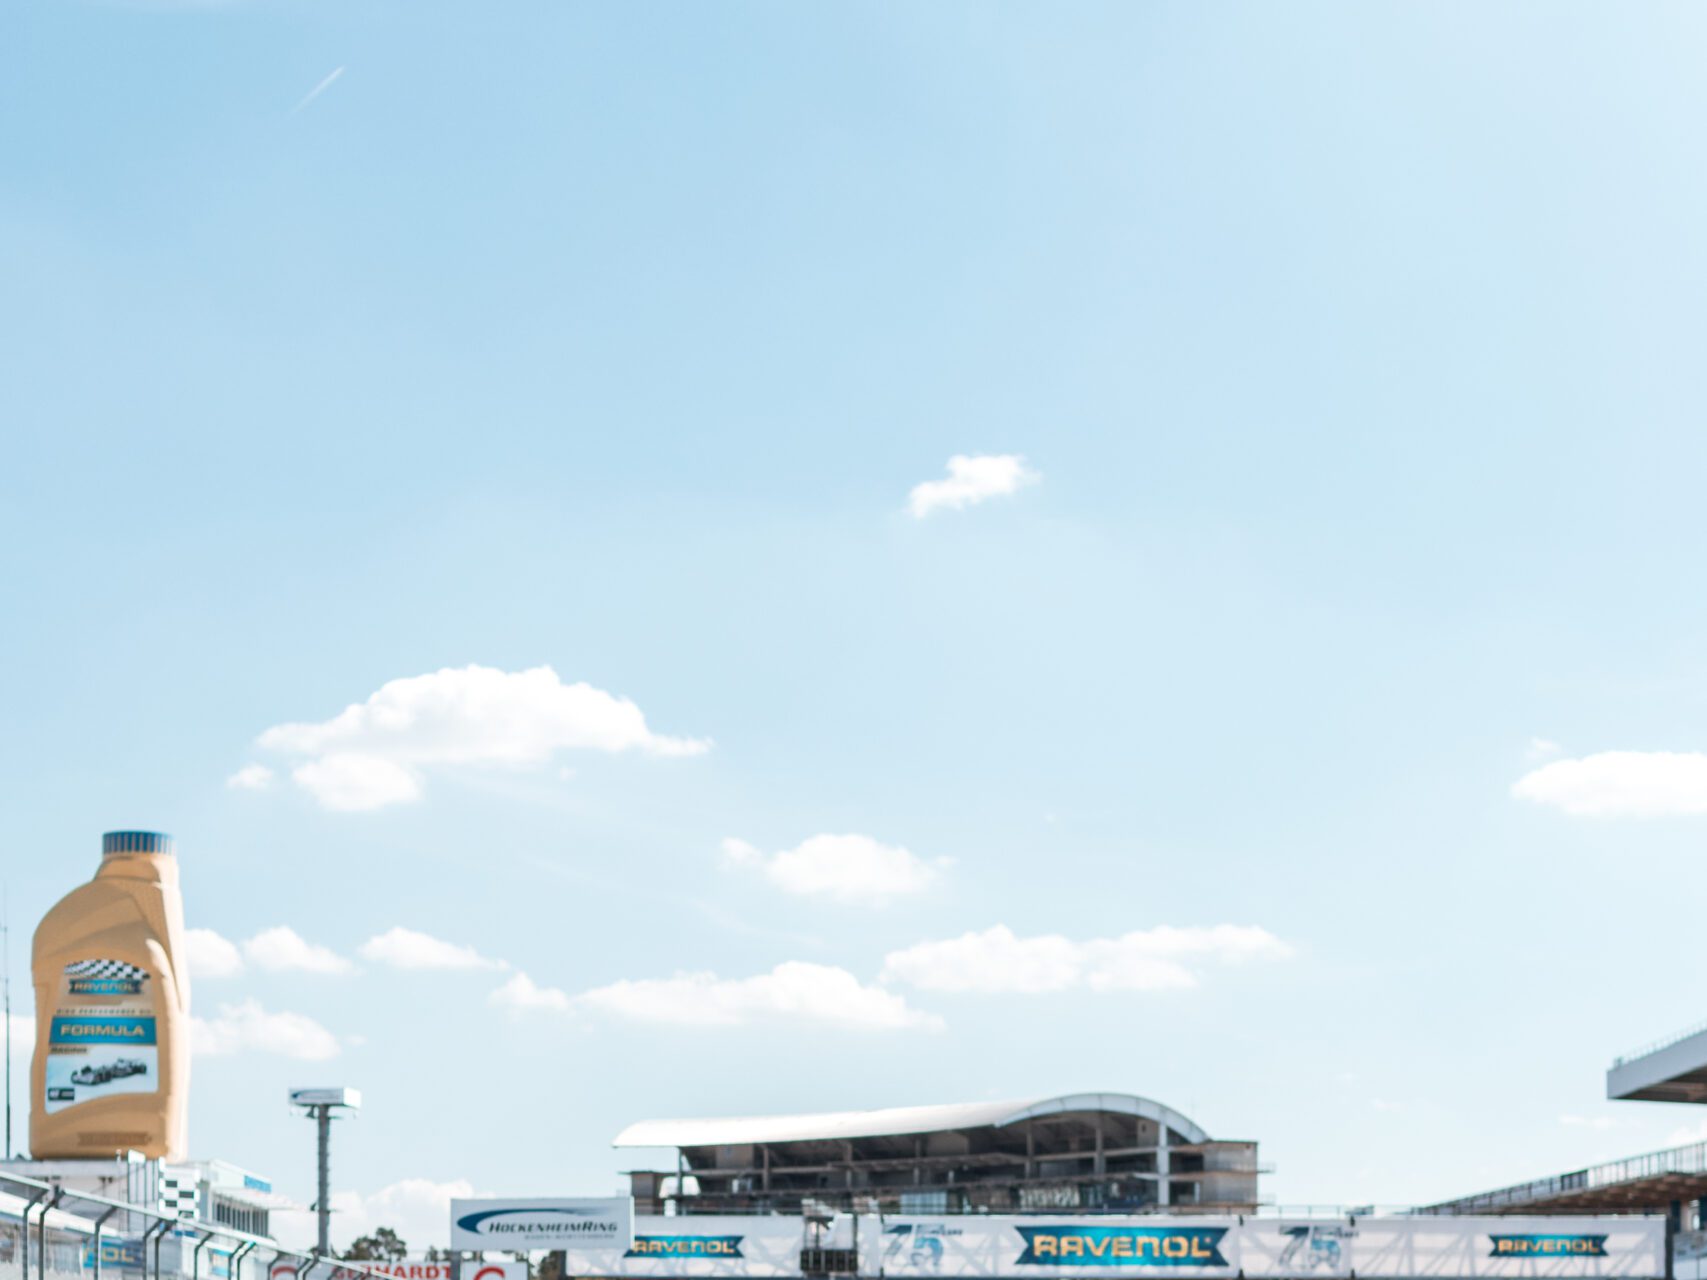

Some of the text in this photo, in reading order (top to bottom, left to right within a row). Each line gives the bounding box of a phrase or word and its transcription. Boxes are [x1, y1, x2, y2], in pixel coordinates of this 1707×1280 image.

[61, 1024, 144, 1037] FORMULA
[634, 1240, 733, 1253] RAVENOL
[1033, 1235, 1210, 1257] RAVENOL
[1498, 1240, 1599, 1253] RAVENOL
